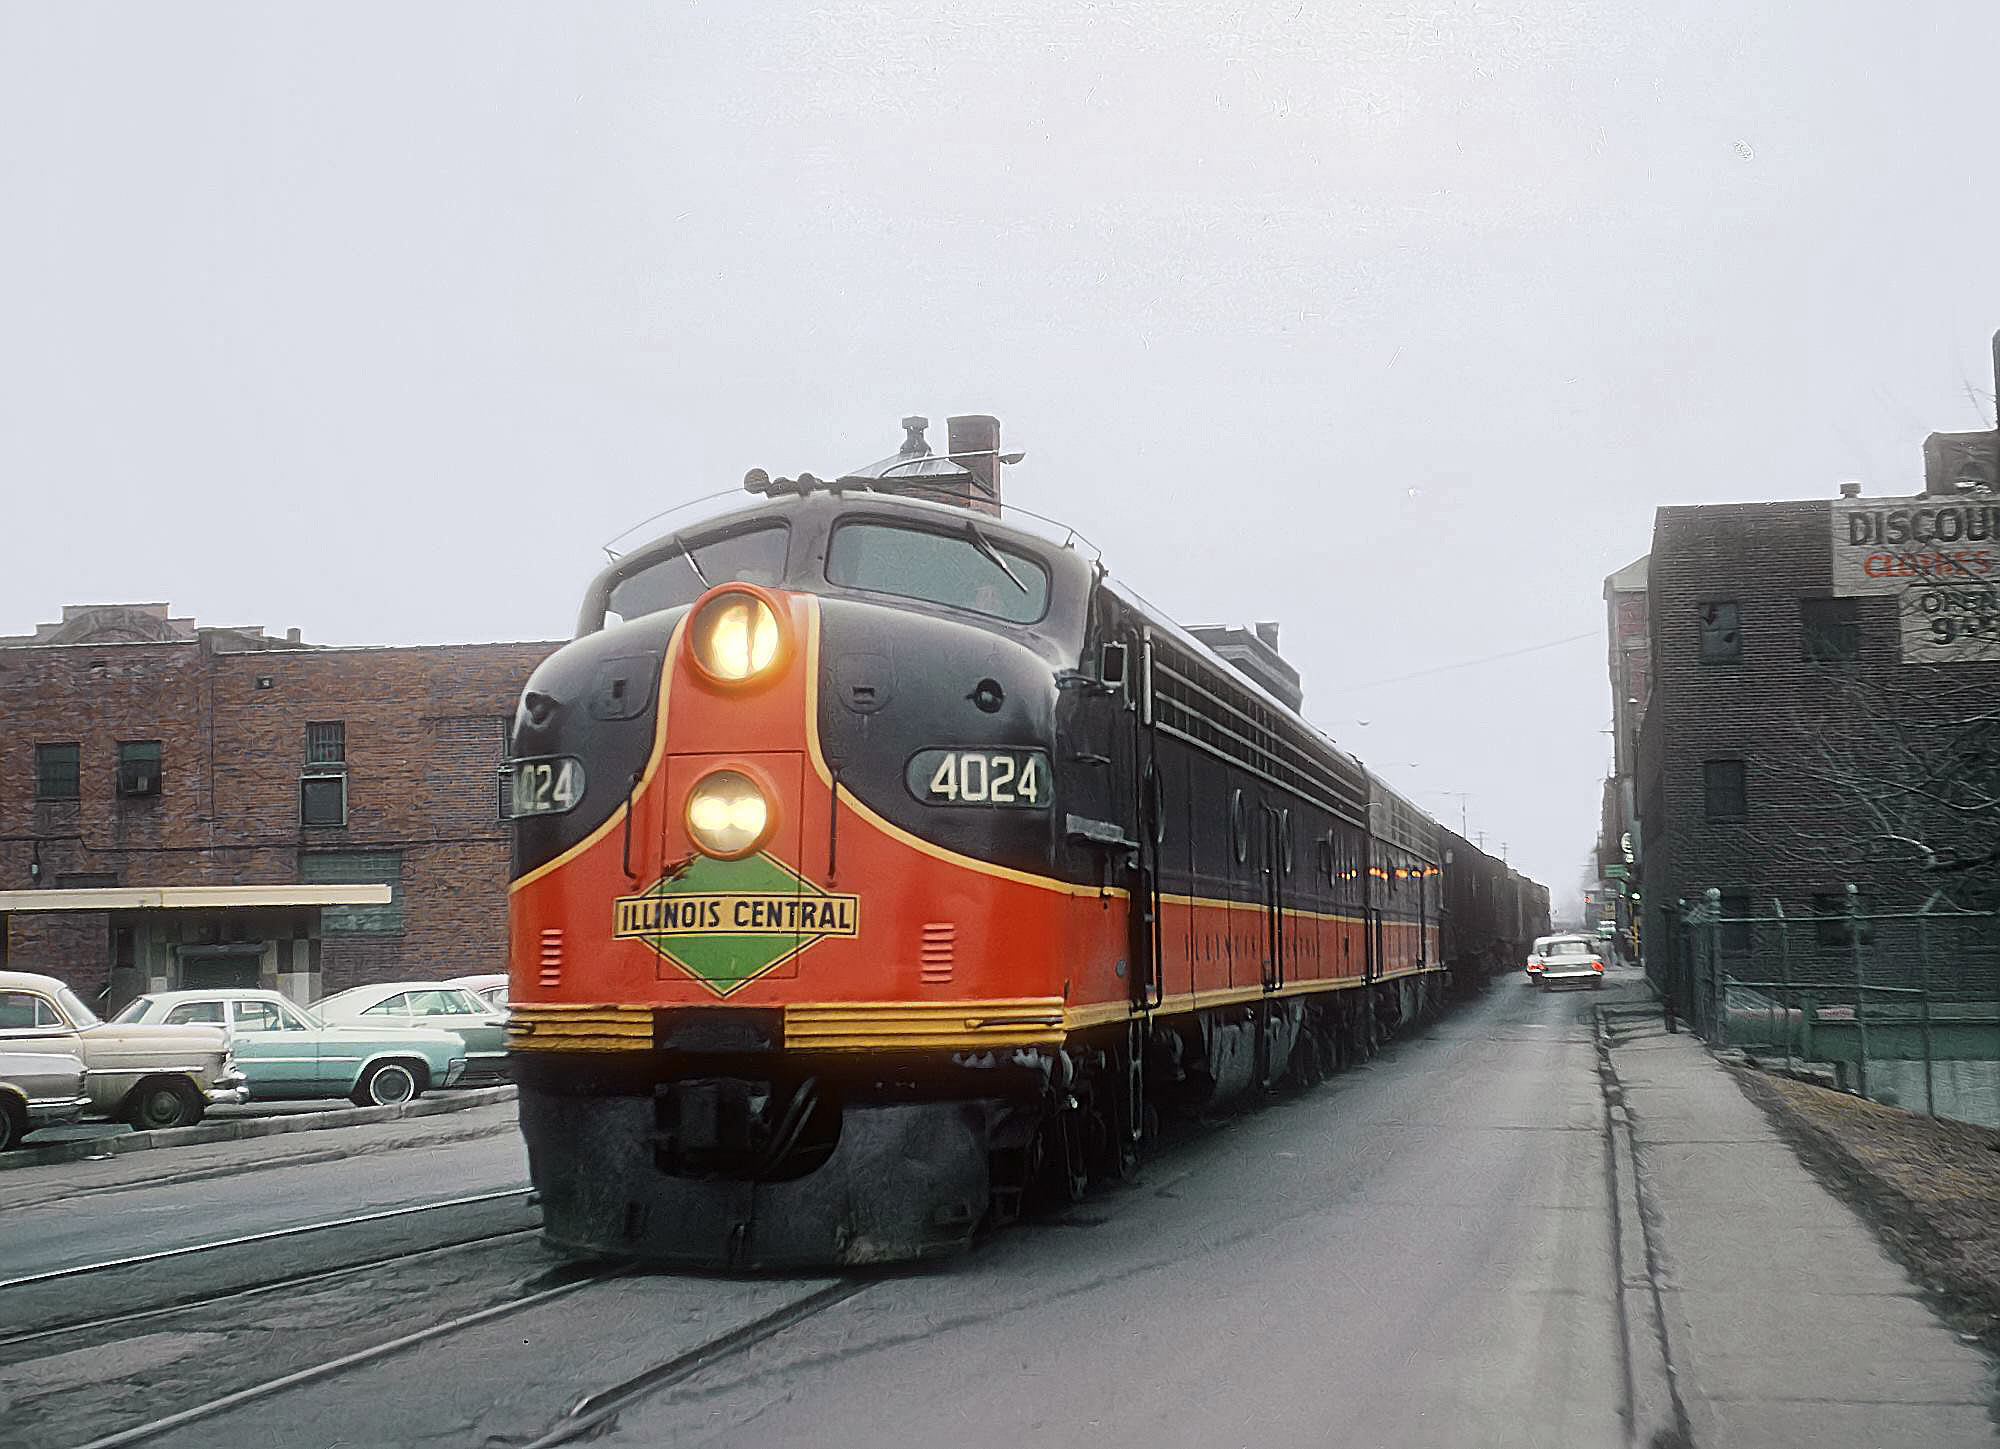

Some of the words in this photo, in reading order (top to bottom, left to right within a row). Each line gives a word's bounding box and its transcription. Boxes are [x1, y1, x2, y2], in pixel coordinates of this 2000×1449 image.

[929, 752, 1038, 803] 4024
[622, 900, 721, 931] ILLINOIS
[733, 900, 851, 930] CENTRAL
